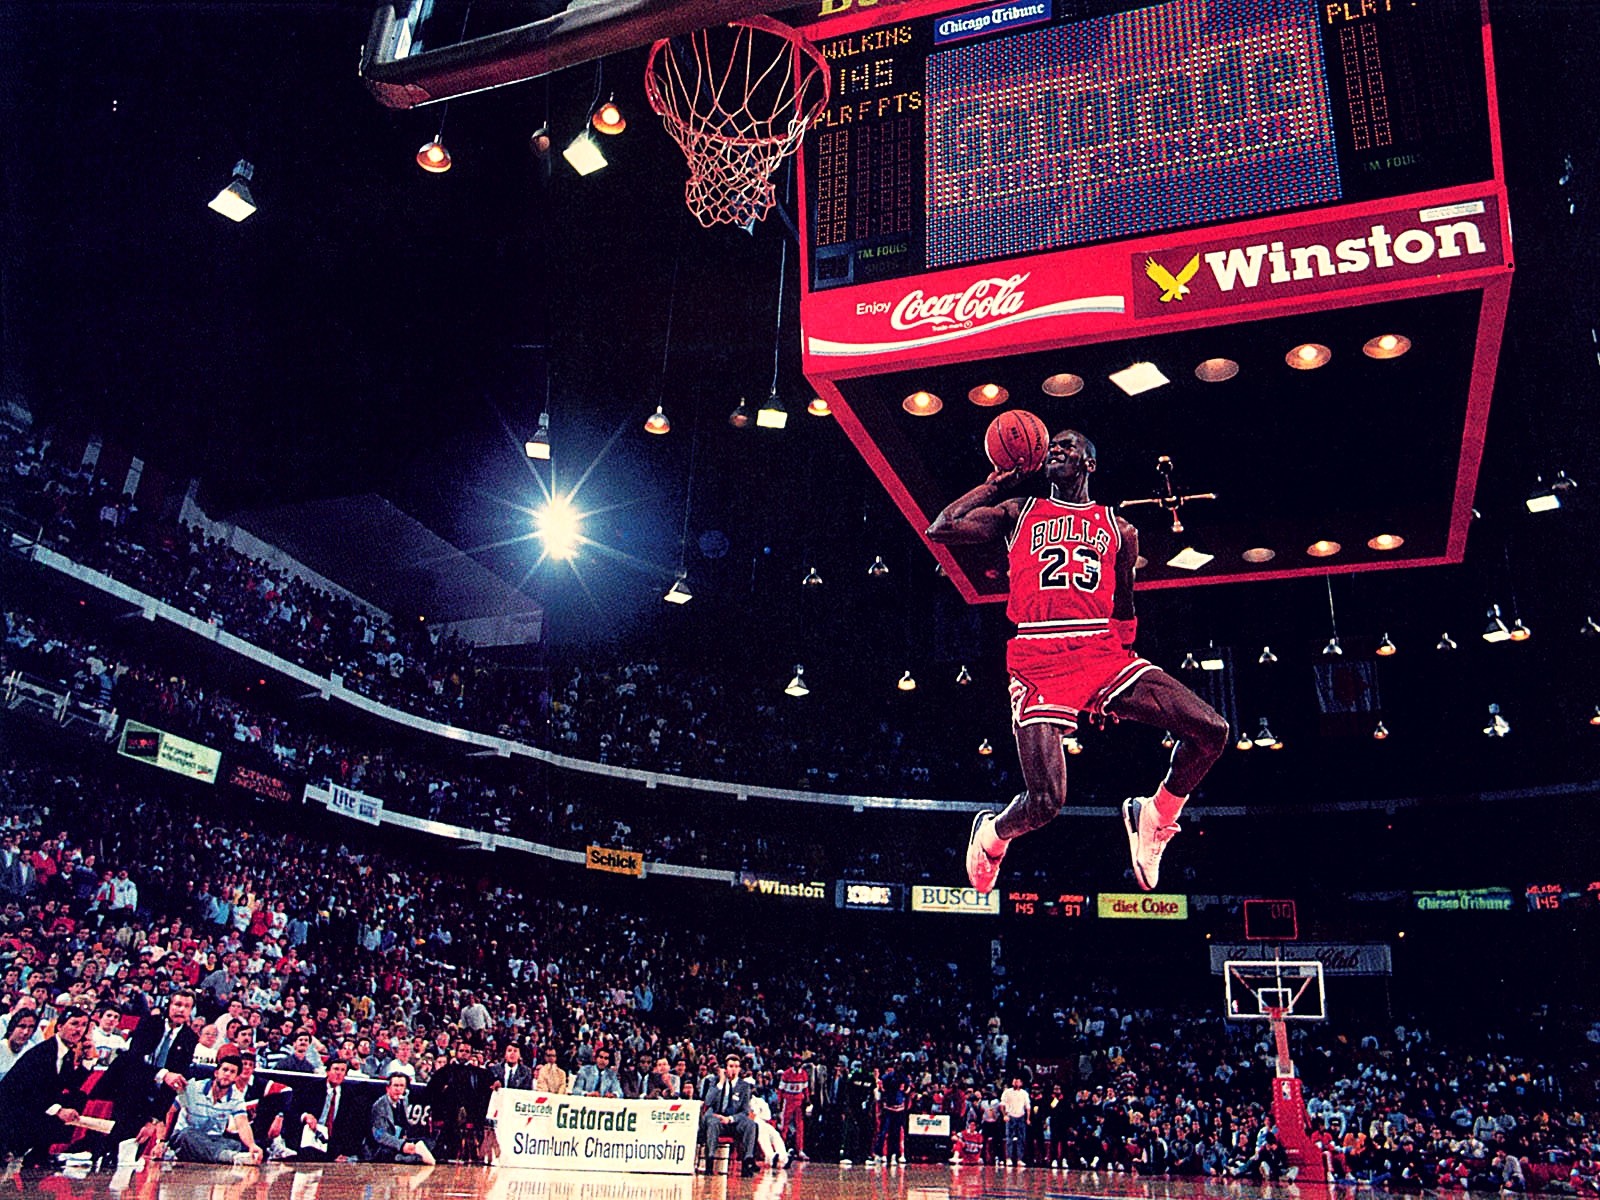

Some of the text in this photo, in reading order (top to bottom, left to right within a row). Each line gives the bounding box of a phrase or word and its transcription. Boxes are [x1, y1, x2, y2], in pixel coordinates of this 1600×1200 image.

[939, 4, 1045, 36] Chicago Tribune
[822, 26, 912, 59] WILKINS
[840, 58, 894, 95] 145
[1205, 219, 1486, 292] Winston
[856, 272, 1031, 331] Enjoy Coca-Cola
[1031, 515, 1110, 555] BULLS
[1039, 545, 1101, 593] 23
[591, 850, 637, 869] Schick
[758, 879, 825, 899] Winston
[922, 888, 991, 906] BUSCH
[1535, 895, 1559, 909] 145
[1015, 902, 1081, 916] 145 97
[1112, 901, 1138, 913] diet
[1141, 898, 1179, 914] Coke
[556, 1104, 637, 1132] Gatorade
[651, 1110, 691, 1121] Gatorade
[585, 1136, 686, 1164] Championship
